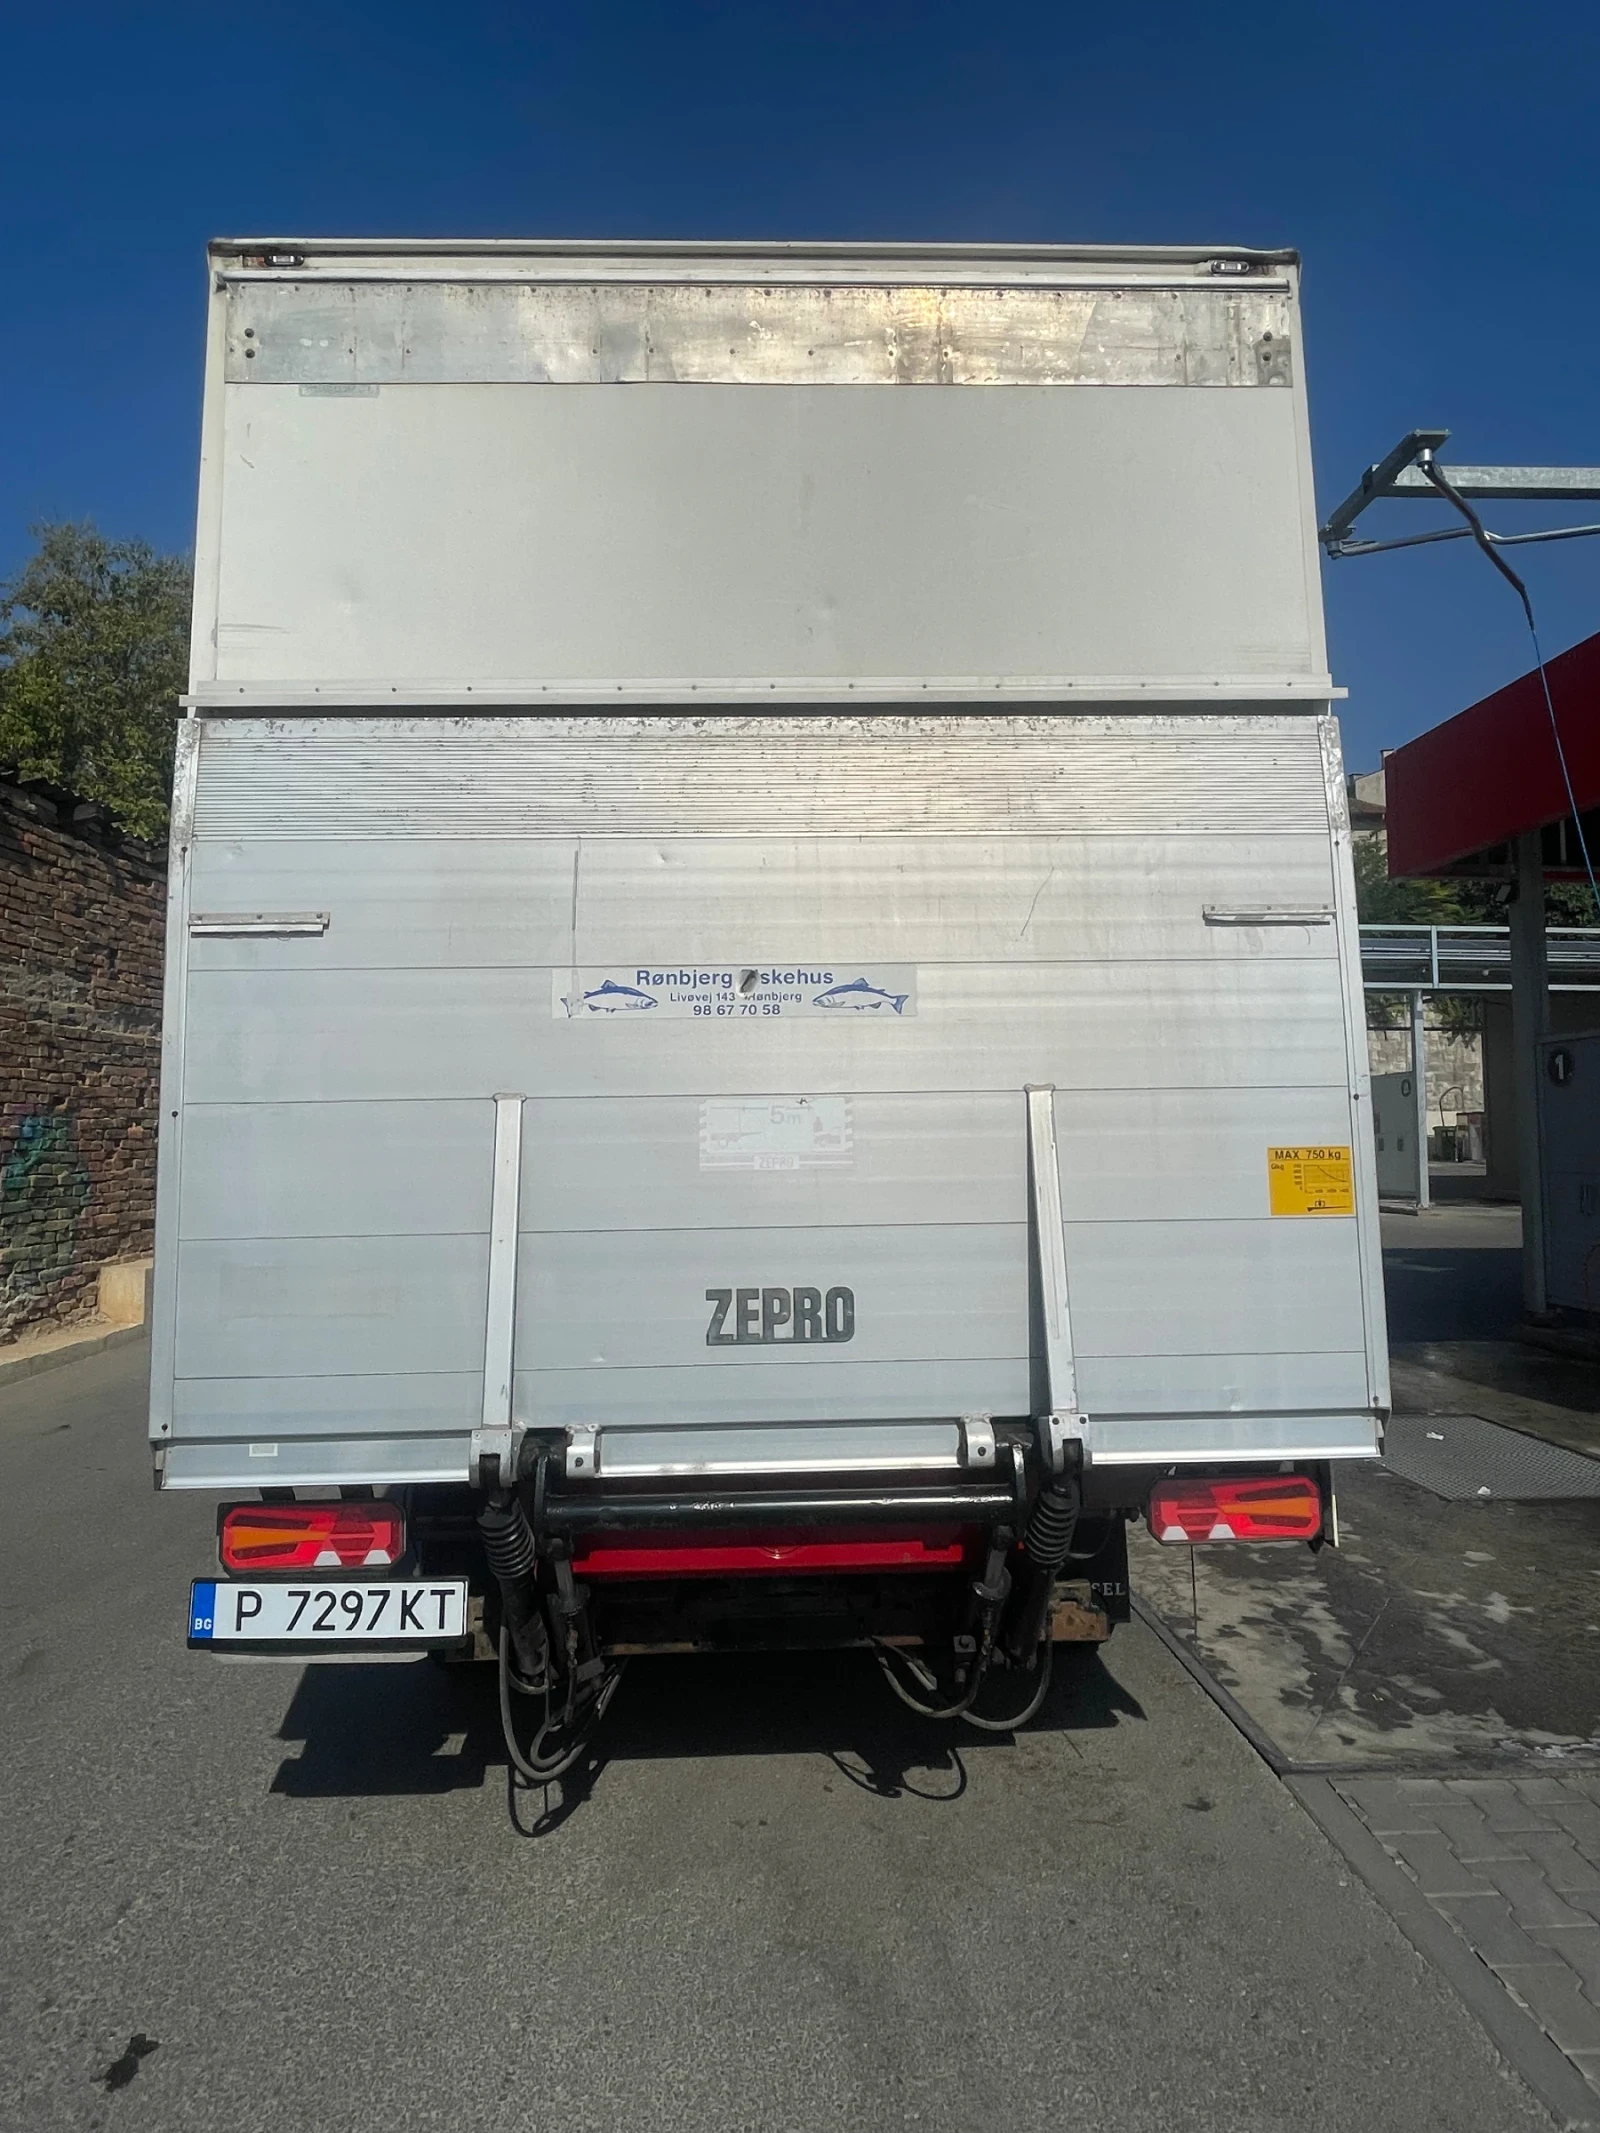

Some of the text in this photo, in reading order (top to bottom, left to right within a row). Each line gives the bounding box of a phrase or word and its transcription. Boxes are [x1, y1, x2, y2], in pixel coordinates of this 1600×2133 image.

[636, 968, 835, 989] Rønbjerg skehus
[670, 992, 712, 1004] Livøvej
[716, 992, 736, 1002] 143
[693, 1004, 781, 1016] 98 67 70 58
[1554, 1054, 1564, 1080] 1
[1275, 1149, 1341, 1161] MAX 750 kg
[705, 1286, 855, 1346] ZEPRO
[194, 1618, 212, 1631] BG
